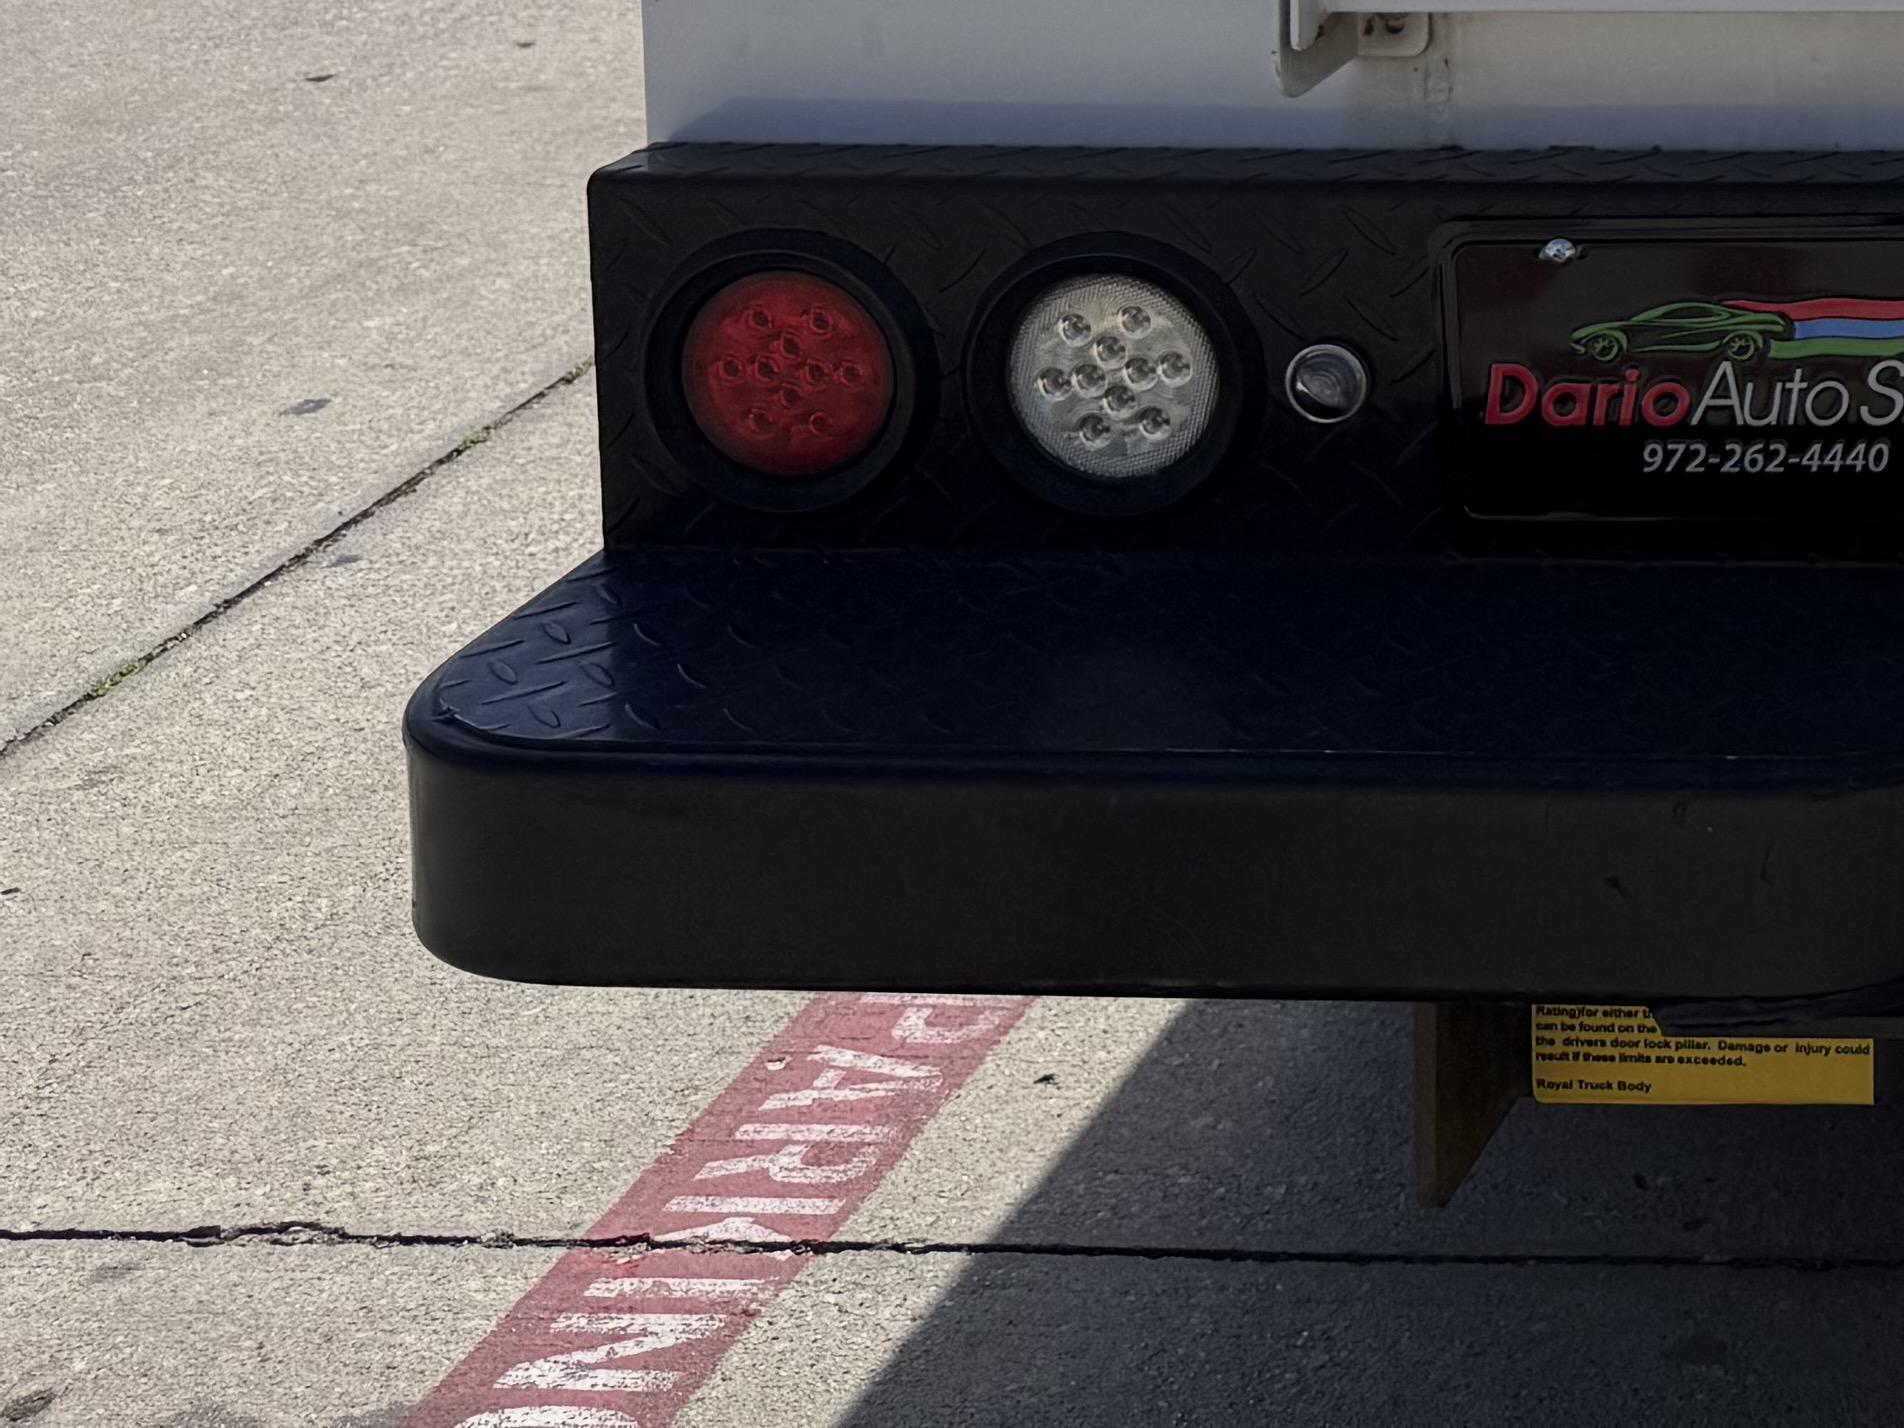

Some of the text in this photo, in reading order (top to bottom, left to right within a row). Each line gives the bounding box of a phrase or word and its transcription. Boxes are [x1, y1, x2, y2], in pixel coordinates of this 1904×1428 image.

[1485, 363, 1691, 427] Dario
[1691, 361, 1850, 427] Auto
[1641, 443, 1890, 474] 972-262-4440
[1602, 1008, 1640, 1018] either
[1536, 1020, 1657, 1033] can be found on the
[1535, 1036, 1556, 1046] the
[1562, 1036, 1606, 1047] drivers
[1610, 1037, 1641, 1048] door
[1643, 1038, 1672, 1049] lock
[1674, 1039, 1711, 1051] pillar.
[1718, 1040, 1771, 1054] Damage
[1774, 1044, 1788, 1053] or
[1834, 1044, 1870, 1055] could
[1535, 1051, 1747, 1066] result if these limits are exceeded.
[1536, 1078, 1652, 1093] Royal Truck Body
